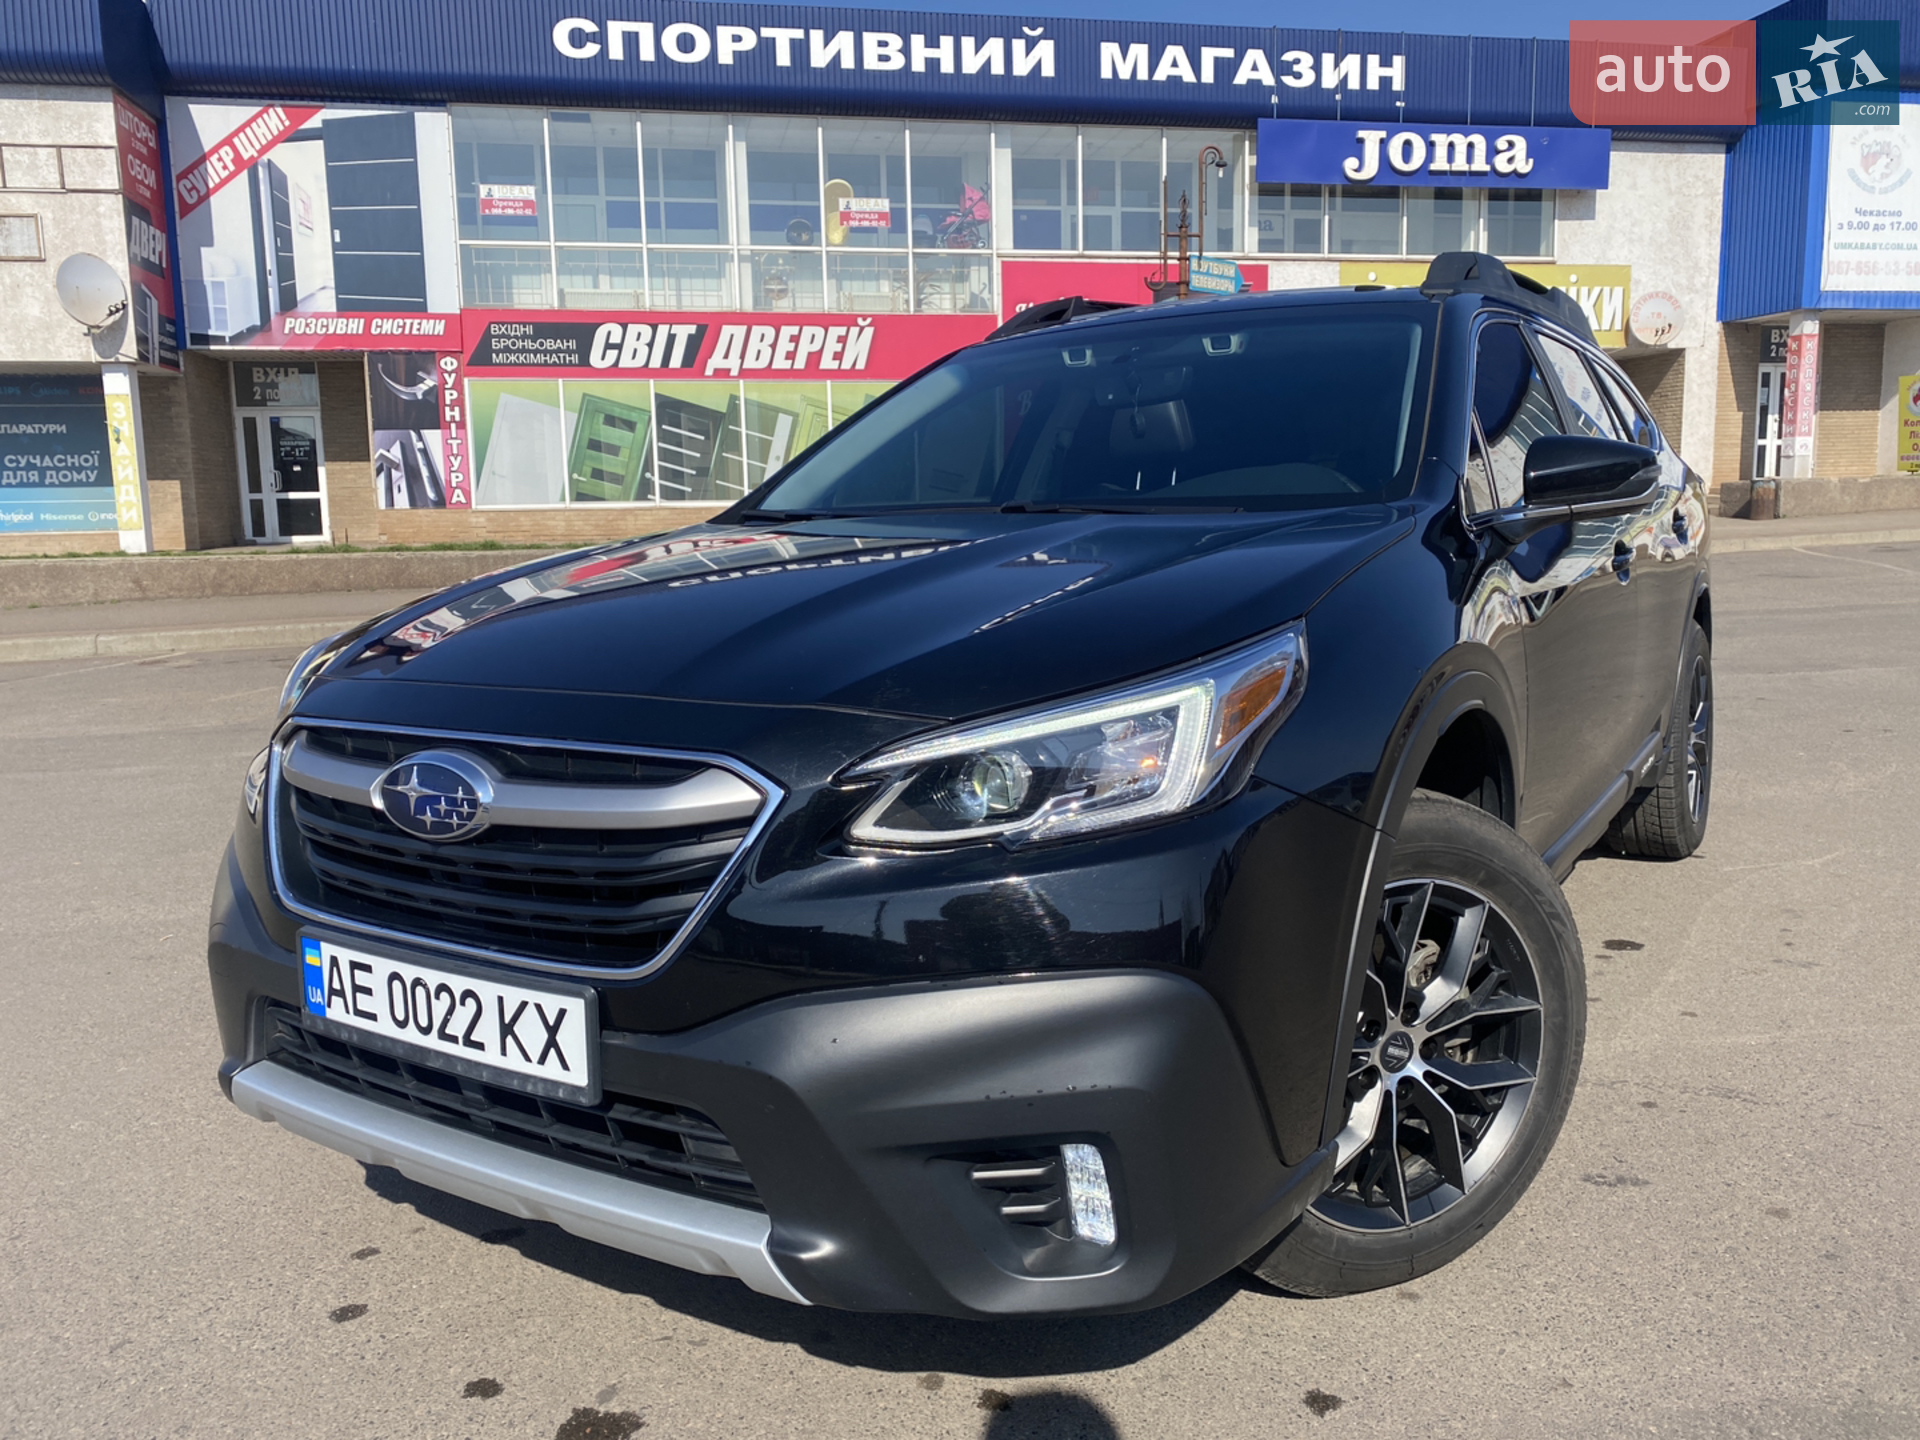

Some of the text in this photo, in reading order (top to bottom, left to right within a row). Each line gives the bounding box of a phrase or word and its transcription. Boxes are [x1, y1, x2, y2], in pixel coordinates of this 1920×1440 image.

[552, 17, 1406, 91] СПОРТИВНИЙ МАГАЗИН
[178, 103, 291, 205] СУПЕР ЦІНИ!
[1343, 130, 1534, 181] Joma
[498, 186, 532, 196] IDEAL
[1847, 220, 1870, 230] 9.00
[1872, 223, 1886, 232] до
[1890, 221, 1918, 231] 17.00
[130, 215, 166, 268] ДВЕРІ
[284, 317, 446, 336] РОЗСУВНІ СИСТЕМИ
[490, 323, 533, 336] ВХІДНІ
[491, 338, 576, 350] БРОНЬОВАНІ
[589, 317, 874, 376] СВІТ ДВЕРЕЙ
[491, 353, 579, 365] МІЖКІМНАТНІ
[253, 386, 261, 400] 2
[1801, 341, 1814, 433] КОЛЯСКИ
[440, 356, 467, 504] ФУРНІТУРА
[4, 450, 100, 467] СУЧАСНОЇ
[1, 470, 98, 485] ДЛЯ ДОМУ
[0, 512, 34, 522] hirlpool
[308, 985, 323, 1006] UA
[326, 955, 571, 1072] AE 0022 KX
